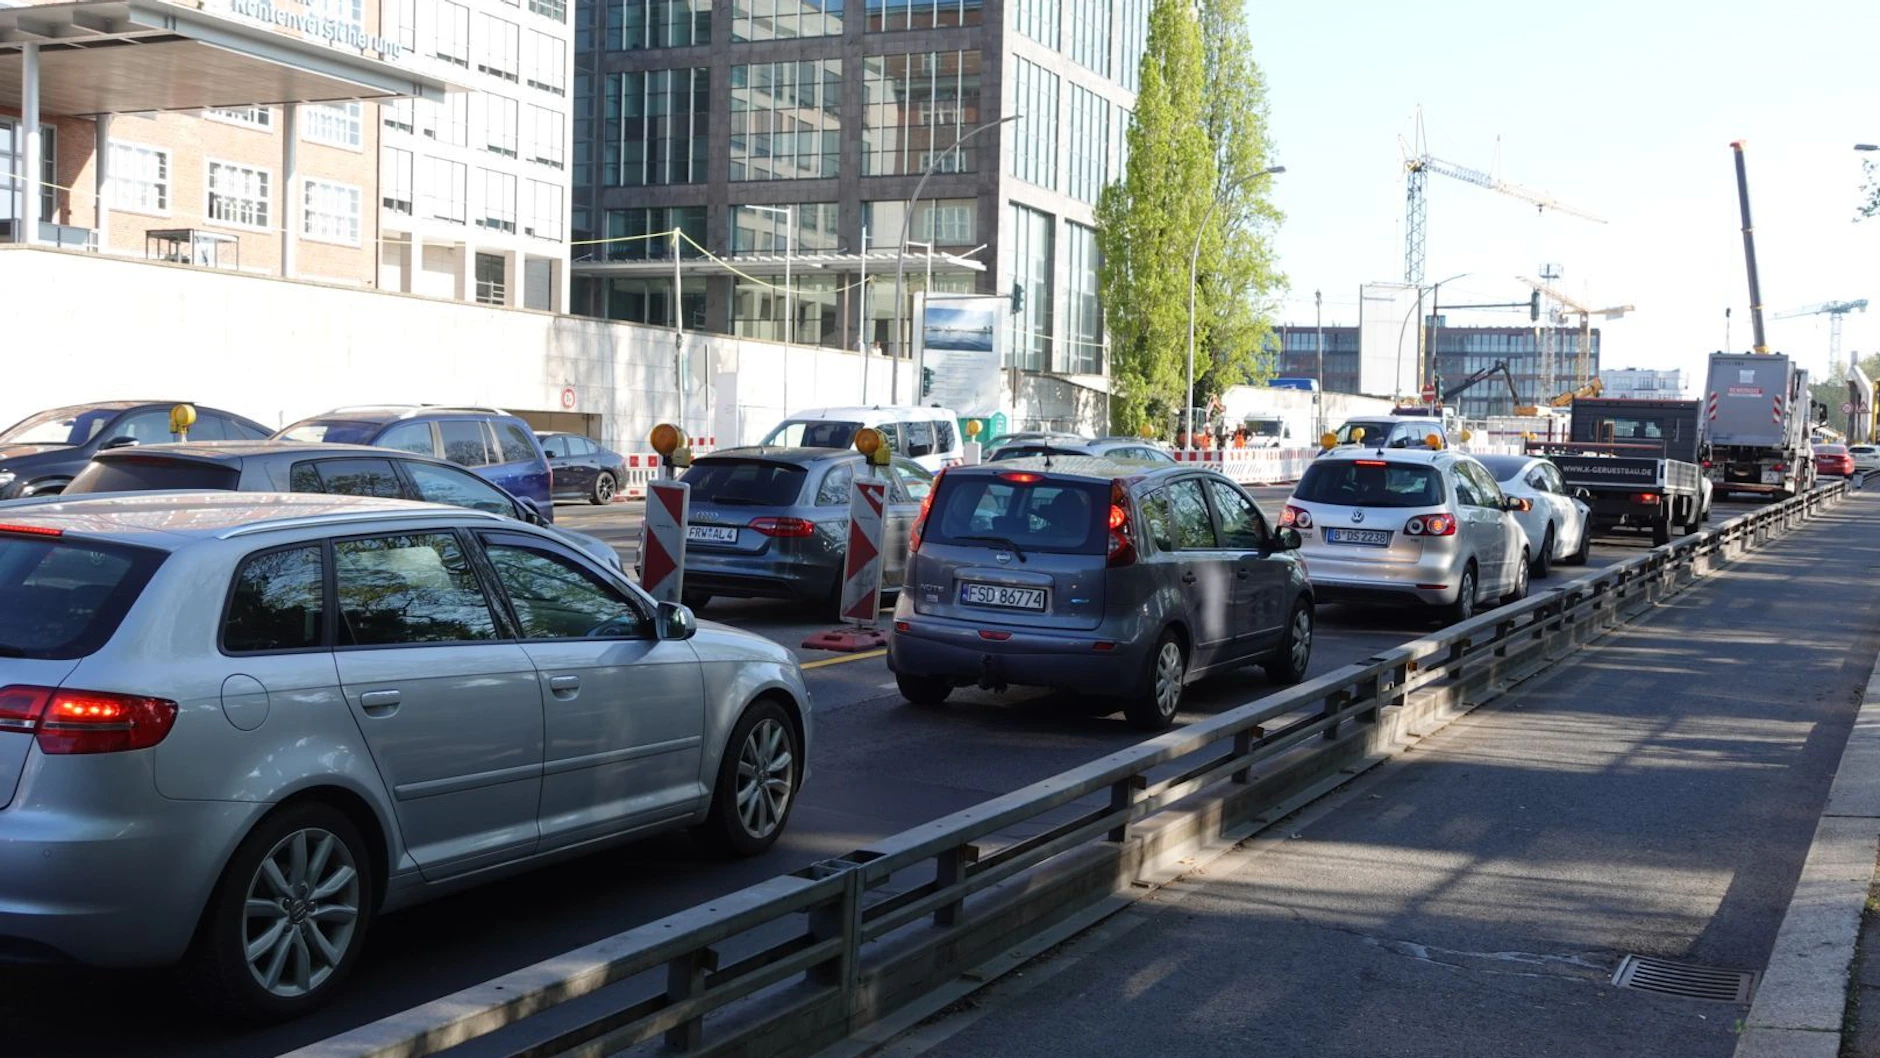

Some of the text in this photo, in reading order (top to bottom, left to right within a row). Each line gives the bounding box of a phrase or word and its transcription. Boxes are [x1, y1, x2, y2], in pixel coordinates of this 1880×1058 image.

[1563, 465, 1652, 476] WWW.K-GERUESTBAU.DE
[688, 527, 733, 539] FRW AL 4
[1334, 530, 1341, 540] B
[1347, 531, 1360, 542] DS
[968, 586, 1042, 607] FSD 86774
